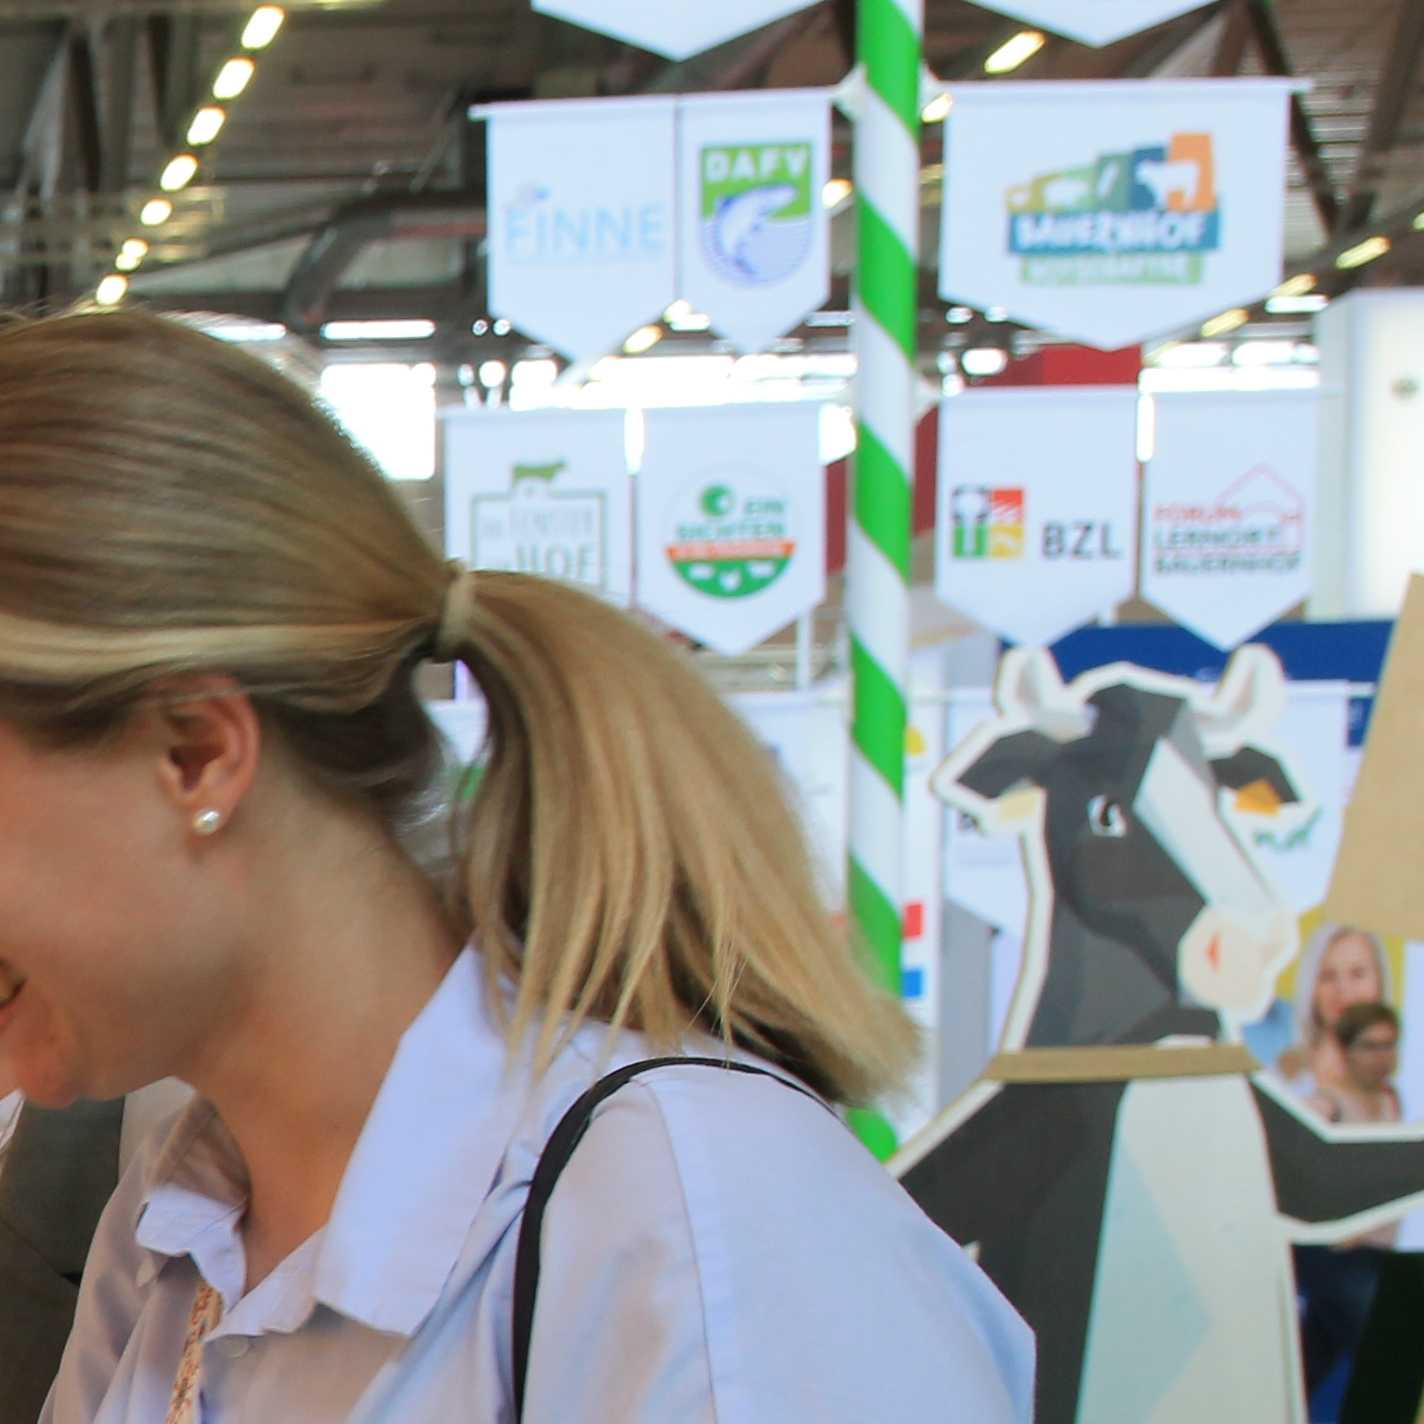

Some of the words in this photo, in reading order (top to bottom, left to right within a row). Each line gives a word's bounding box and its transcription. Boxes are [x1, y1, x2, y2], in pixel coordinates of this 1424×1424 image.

[706, 146, 809, 182] DAFV
[1041, 520, 1122, 560] BZL
[1155, 524, 1282, 547] LERNORT
